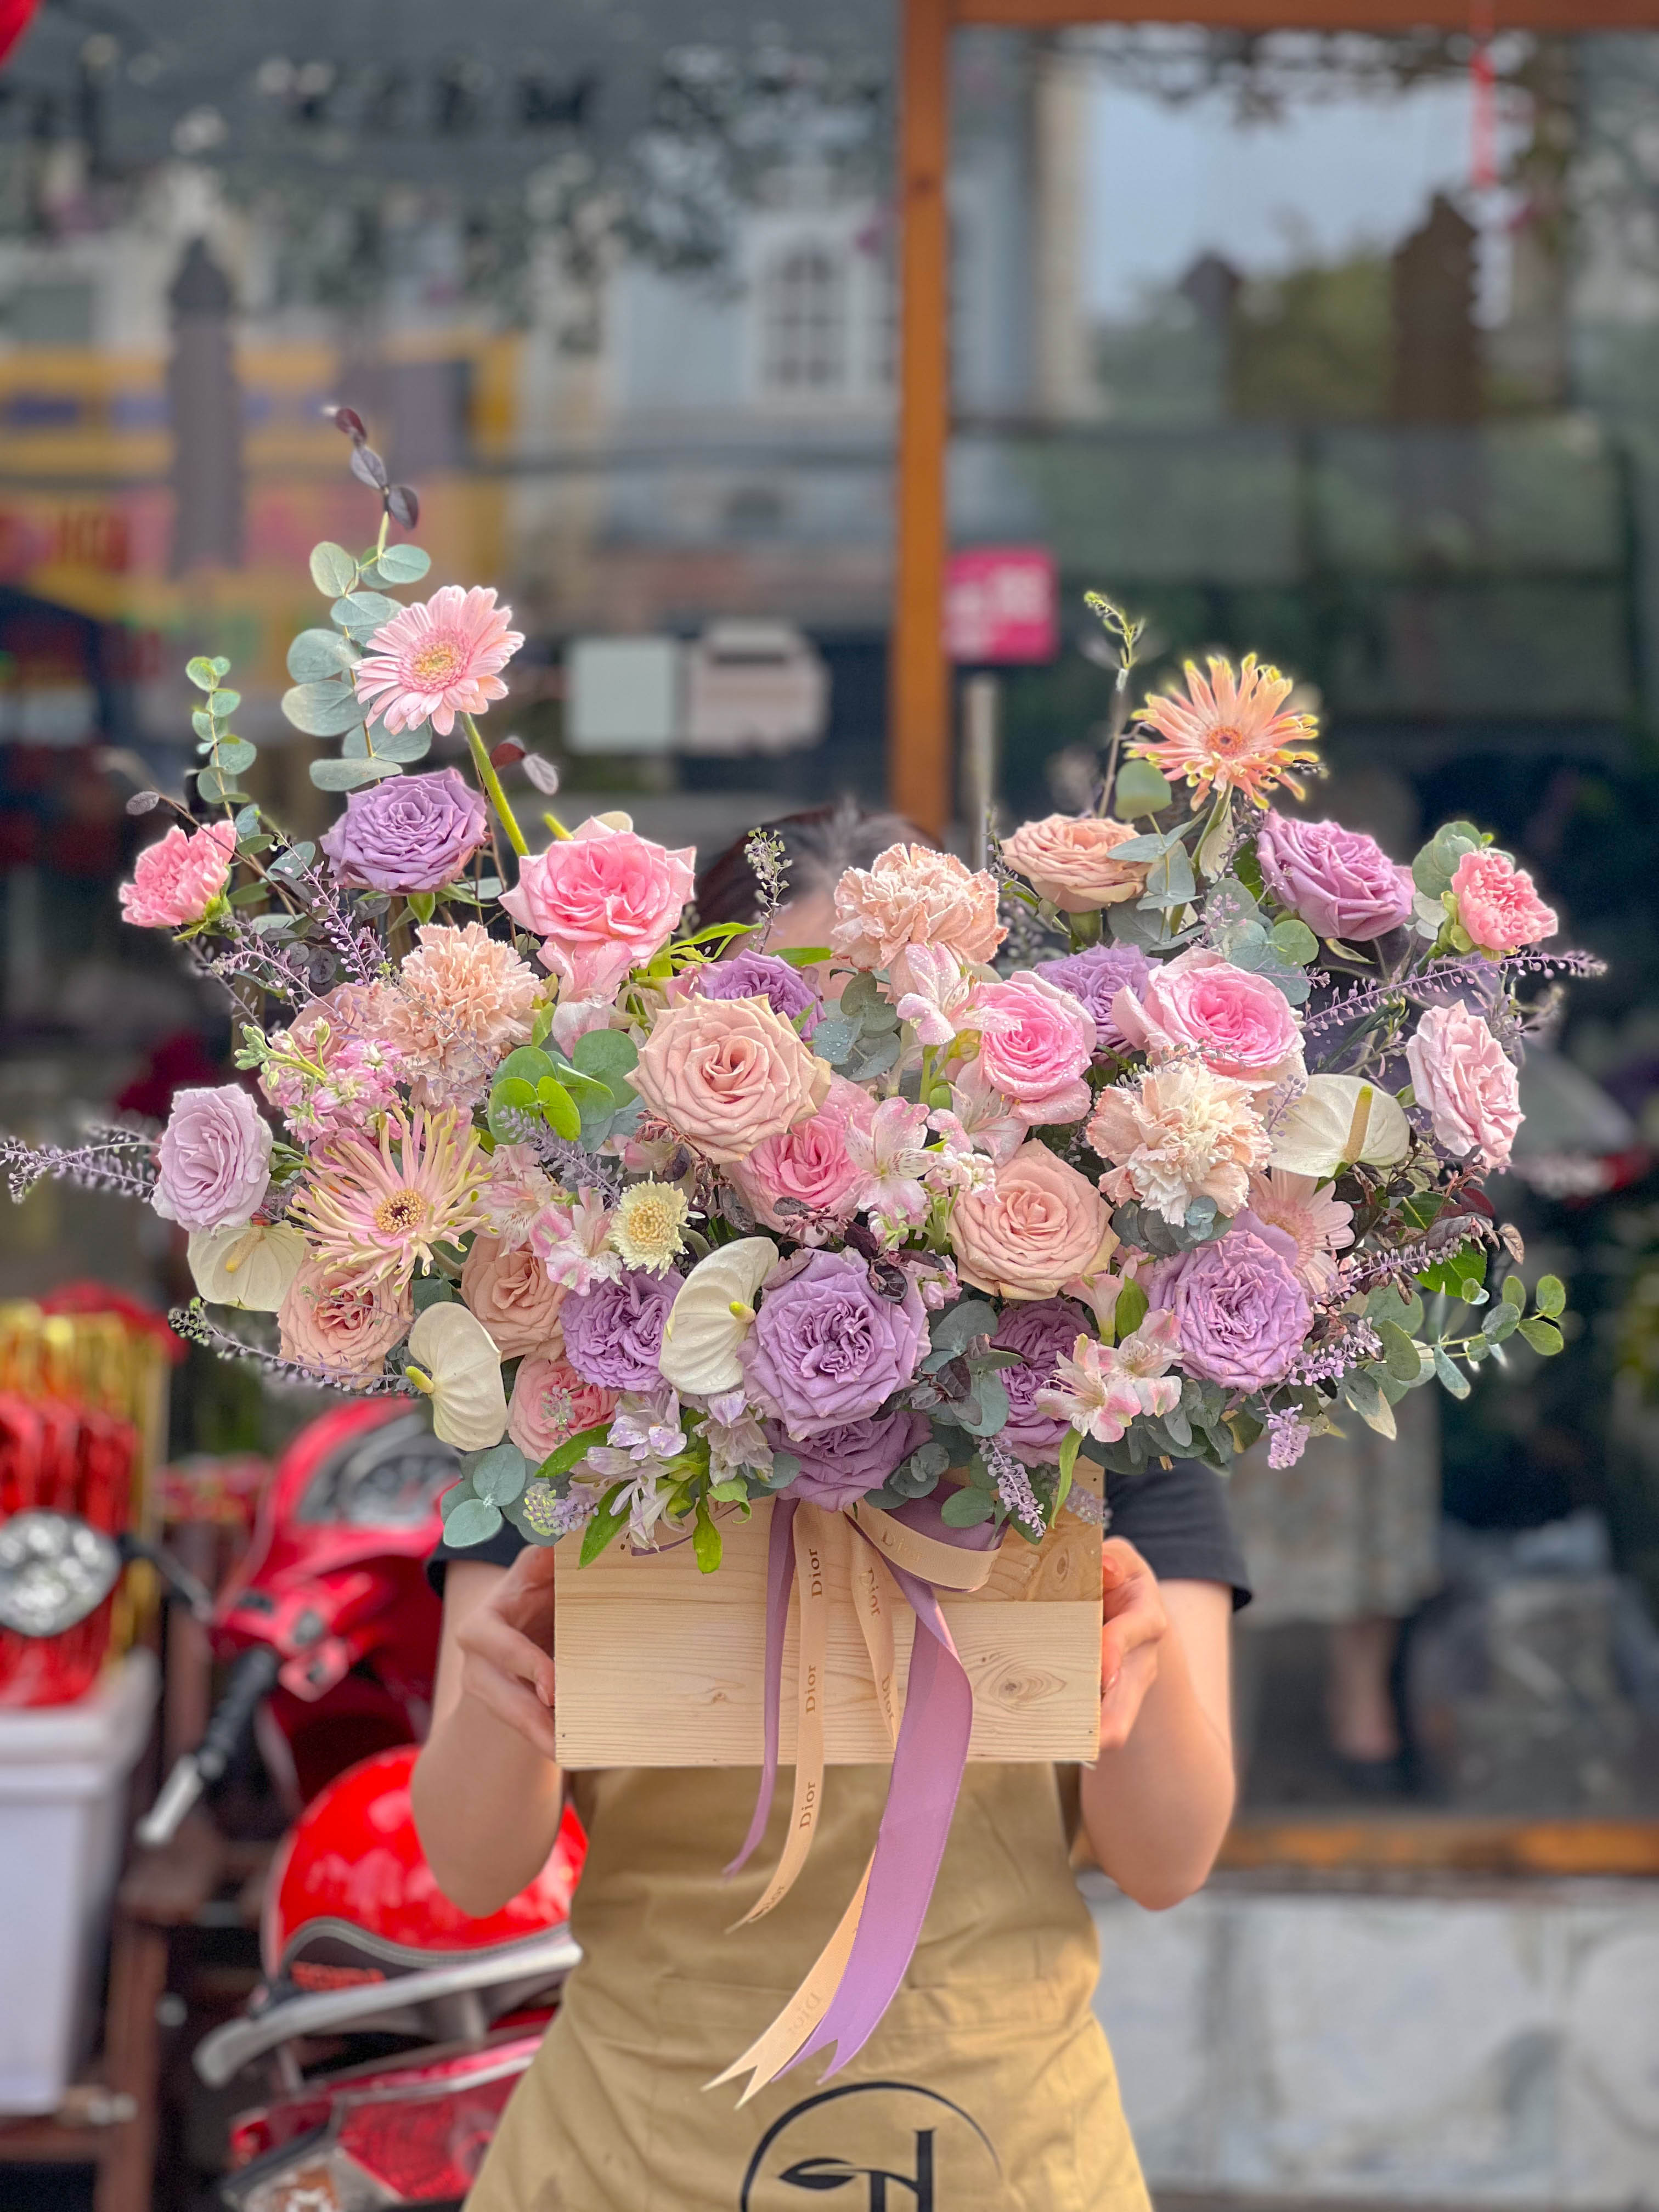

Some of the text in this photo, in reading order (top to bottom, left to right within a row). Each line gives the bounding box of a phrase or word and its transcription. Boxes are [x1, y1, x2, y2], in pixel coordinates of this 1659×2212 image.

[809, 1549, 822, 1597] Dior
[859, 1567, 881, 1616] Dior
[804, 1664, 816, 1715] Dior
[799, 1781, 816, 1830] Dior
